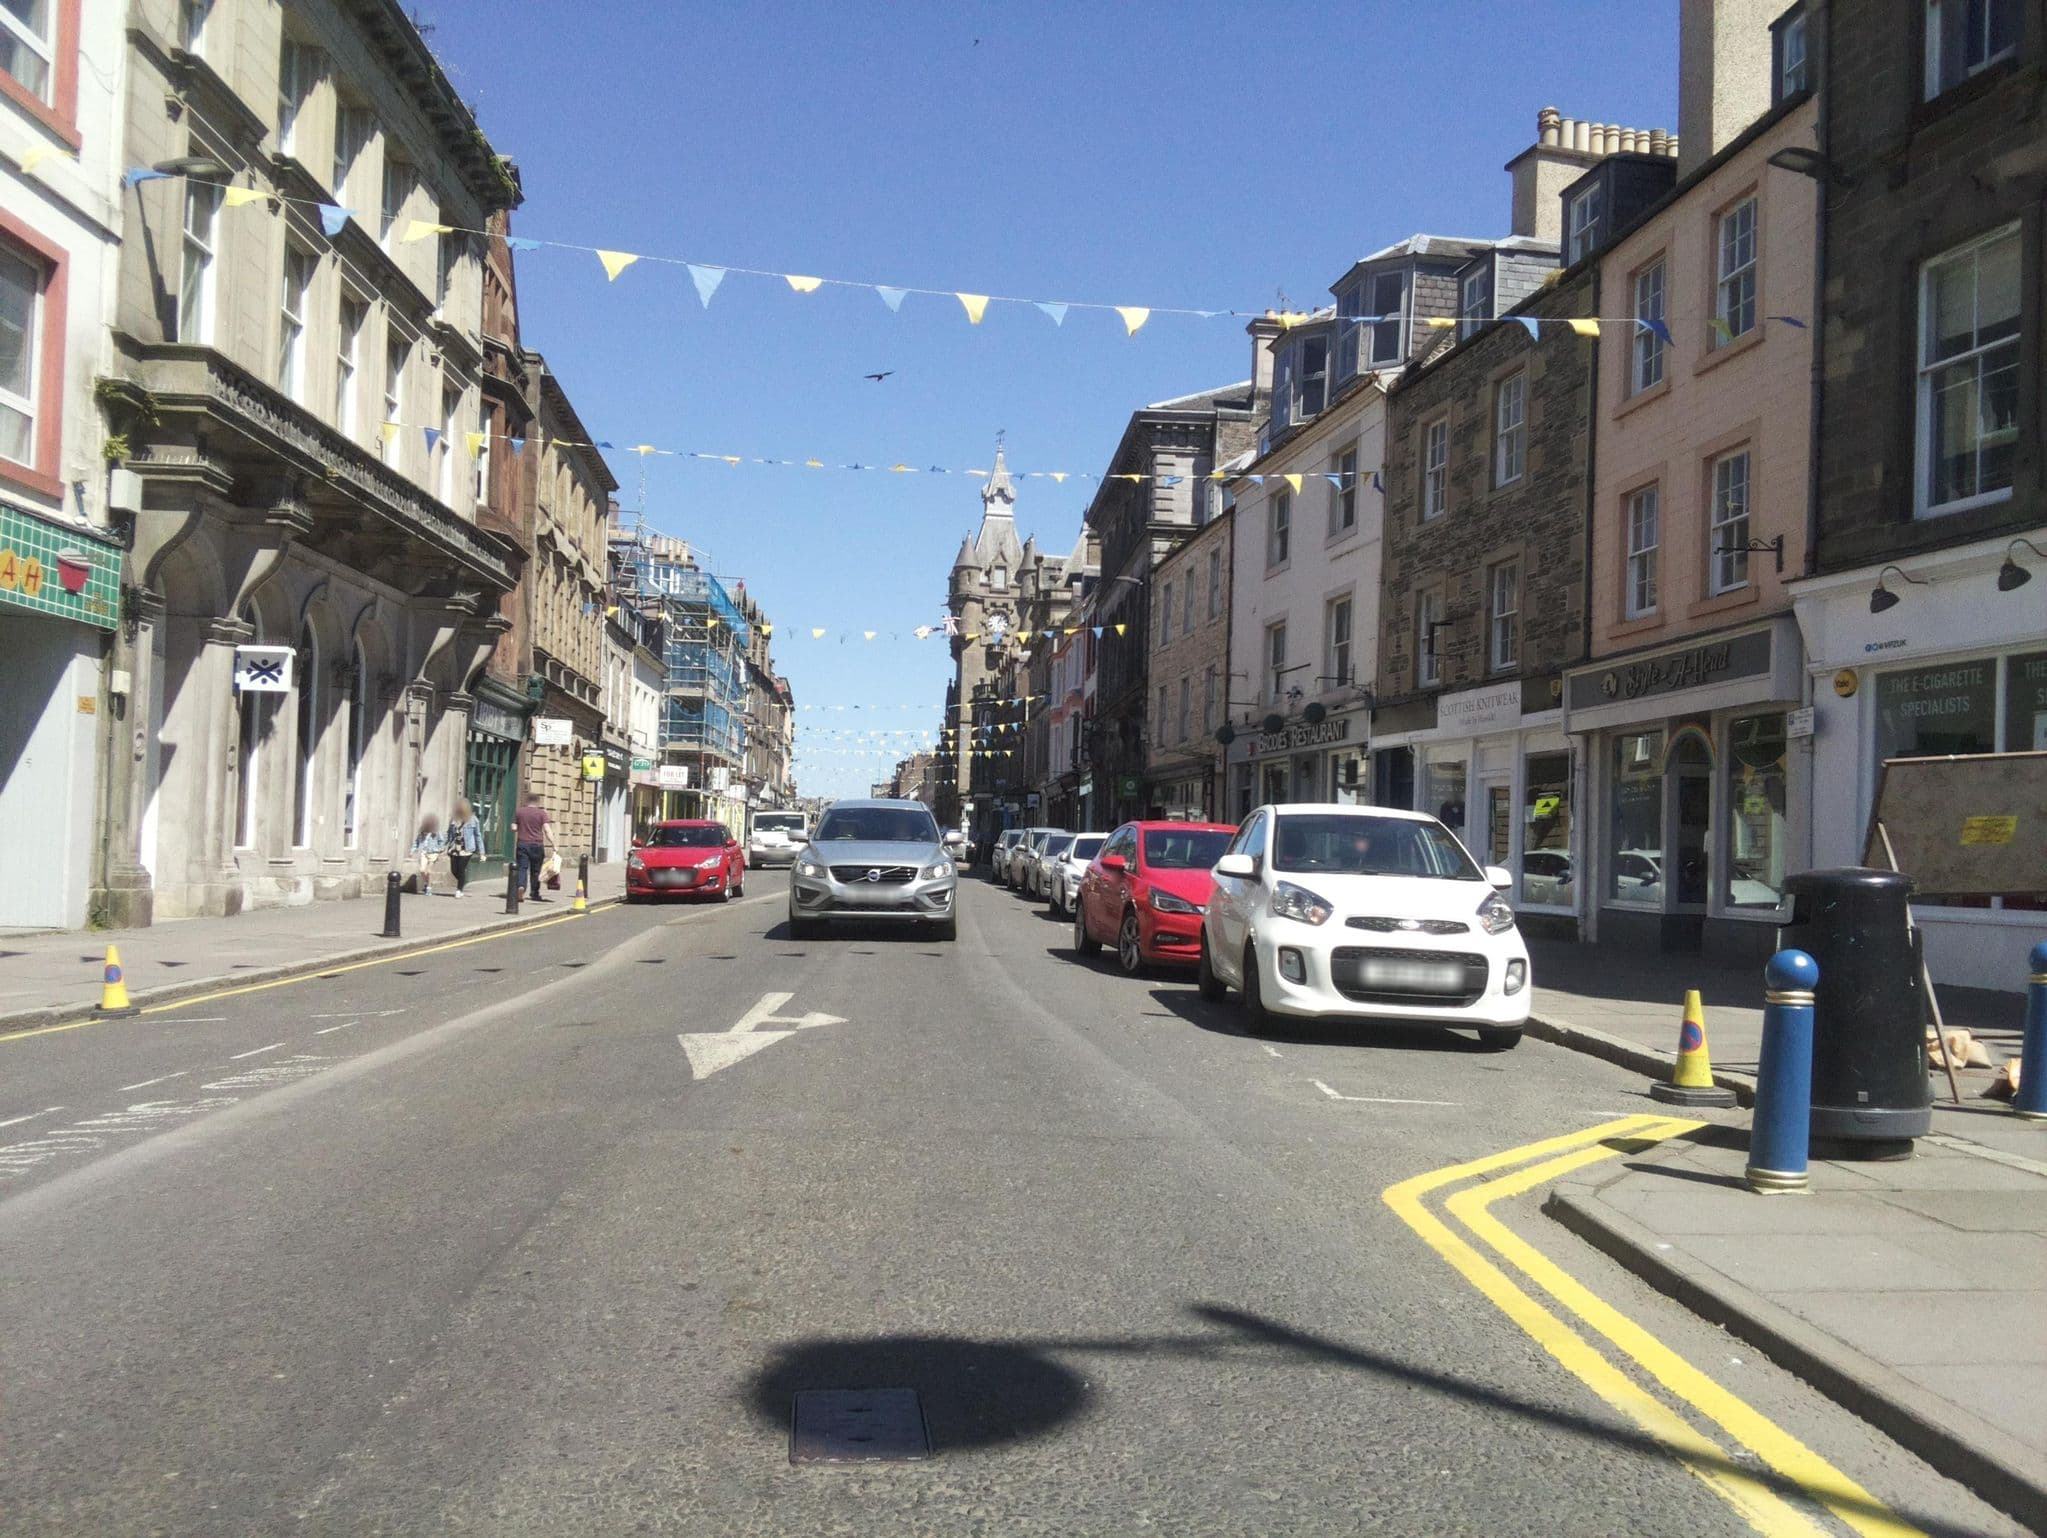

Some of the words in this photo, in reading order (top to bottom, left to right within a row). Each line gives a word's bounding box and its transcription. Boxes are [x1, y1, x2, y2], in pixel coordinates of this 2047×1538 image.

[1889, 678, 1910, 693] THE
[1912, 669, 1983, 692] E-CIGARETTE
[1440, 702, 1474, 716] SCOTTISH
[1901, 696, 1969, 717] SPECIALISTS
[1290, 720, 1345, 747] RESTAURANT
